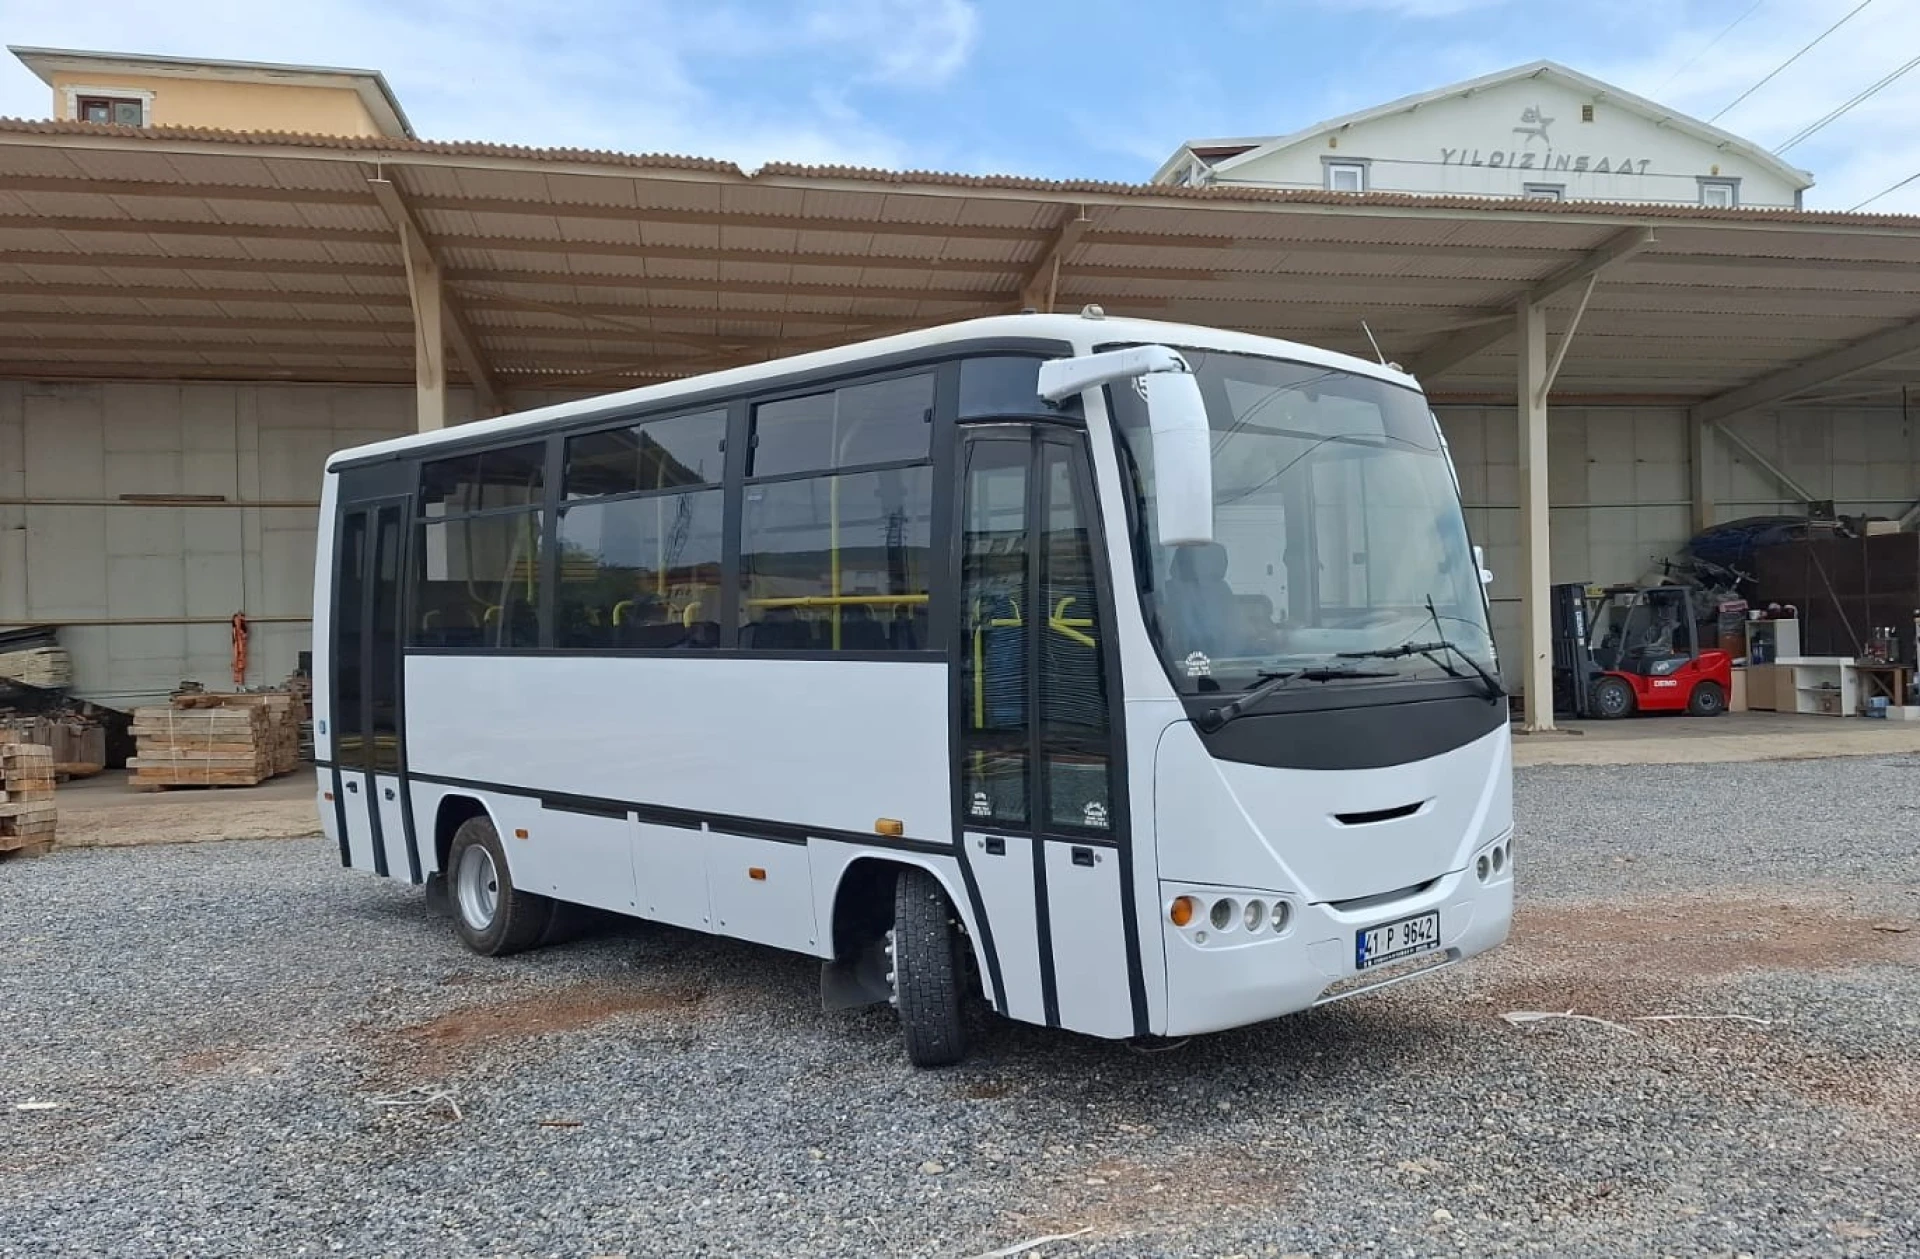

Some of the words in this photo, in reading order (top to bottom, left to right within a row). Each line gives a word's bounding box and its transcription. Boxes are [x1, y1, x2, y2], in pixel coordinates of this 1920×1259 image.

[1441, 147, 1536, 169] YILDIZ
[1365, 932, 1378, 956] 41
[1387, 927, 1394, 951] P
[1403, 918, 1432, 945] 9642
